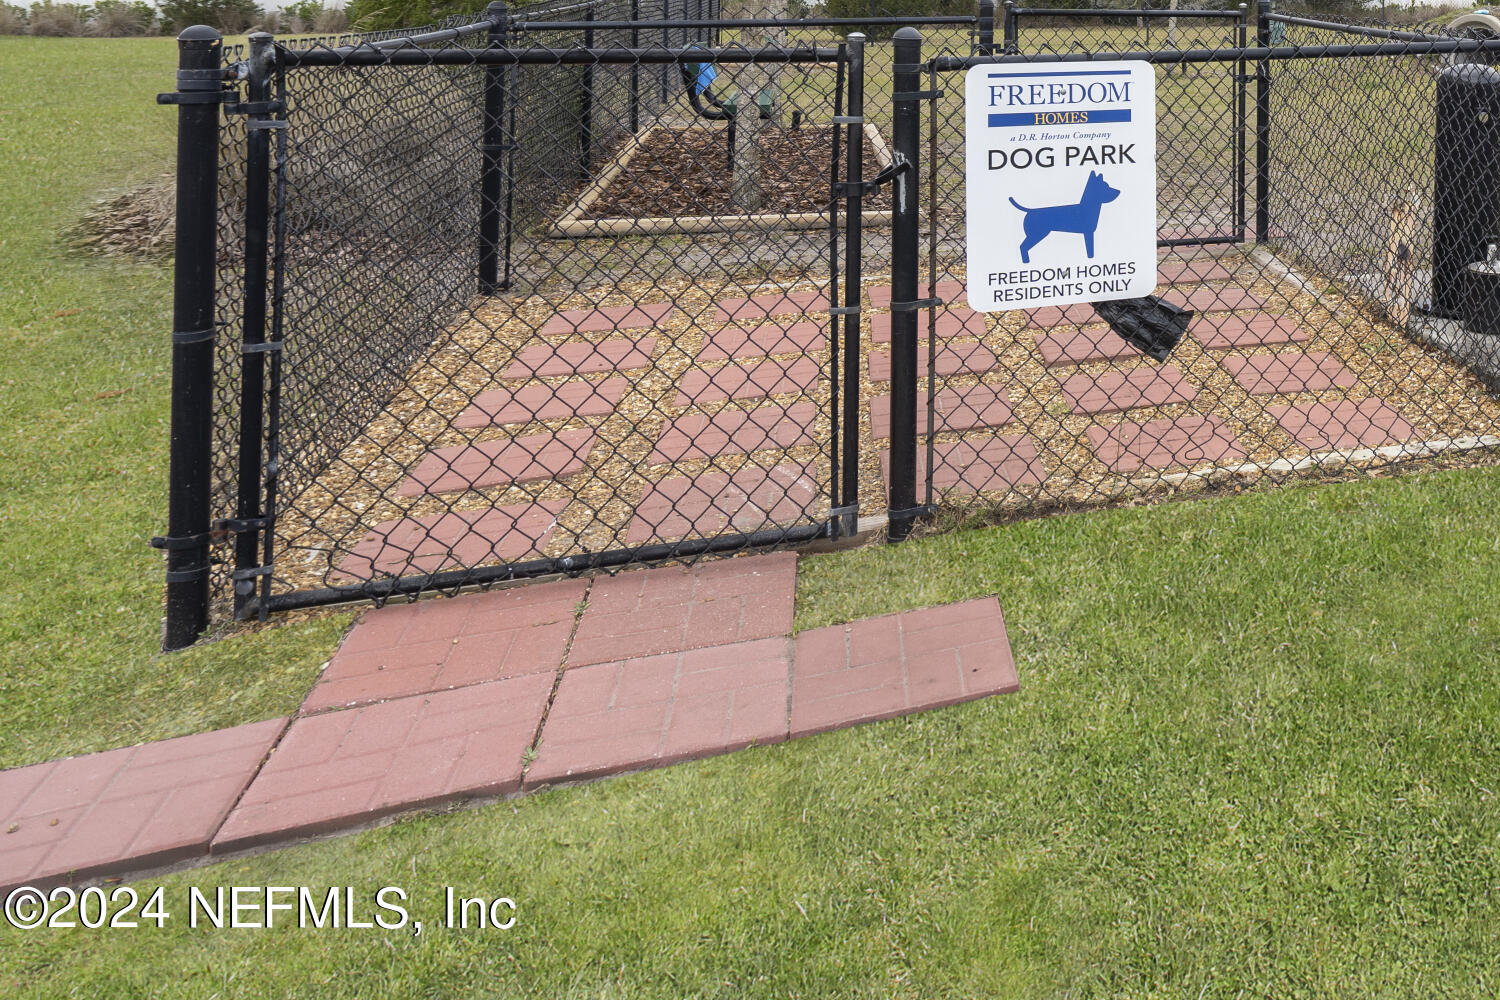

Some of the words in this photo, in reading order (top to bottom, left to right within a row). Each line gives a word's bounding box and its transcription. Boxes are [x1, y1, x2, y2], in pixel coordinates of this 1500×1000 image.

[988, 82, 1133, 107] FREEDOM
[1034, 111, 1089, 126] HOMES
[1018, 133, 1038, 142] D.R.
[1040, 132, 1070, 141] Horton
[1073, 131, 1111, 140] Company
[988, 147, 1055, 171] DOG
[1065, 143, 1136, 167] PARK
[988, 267, 1071, 286] FREEDOM
[1076, 261, 1136, 280] HOMES
[993, 283, 1083, 303] RESIDENTS
[1088, 278, 1132, 295] ONLY
